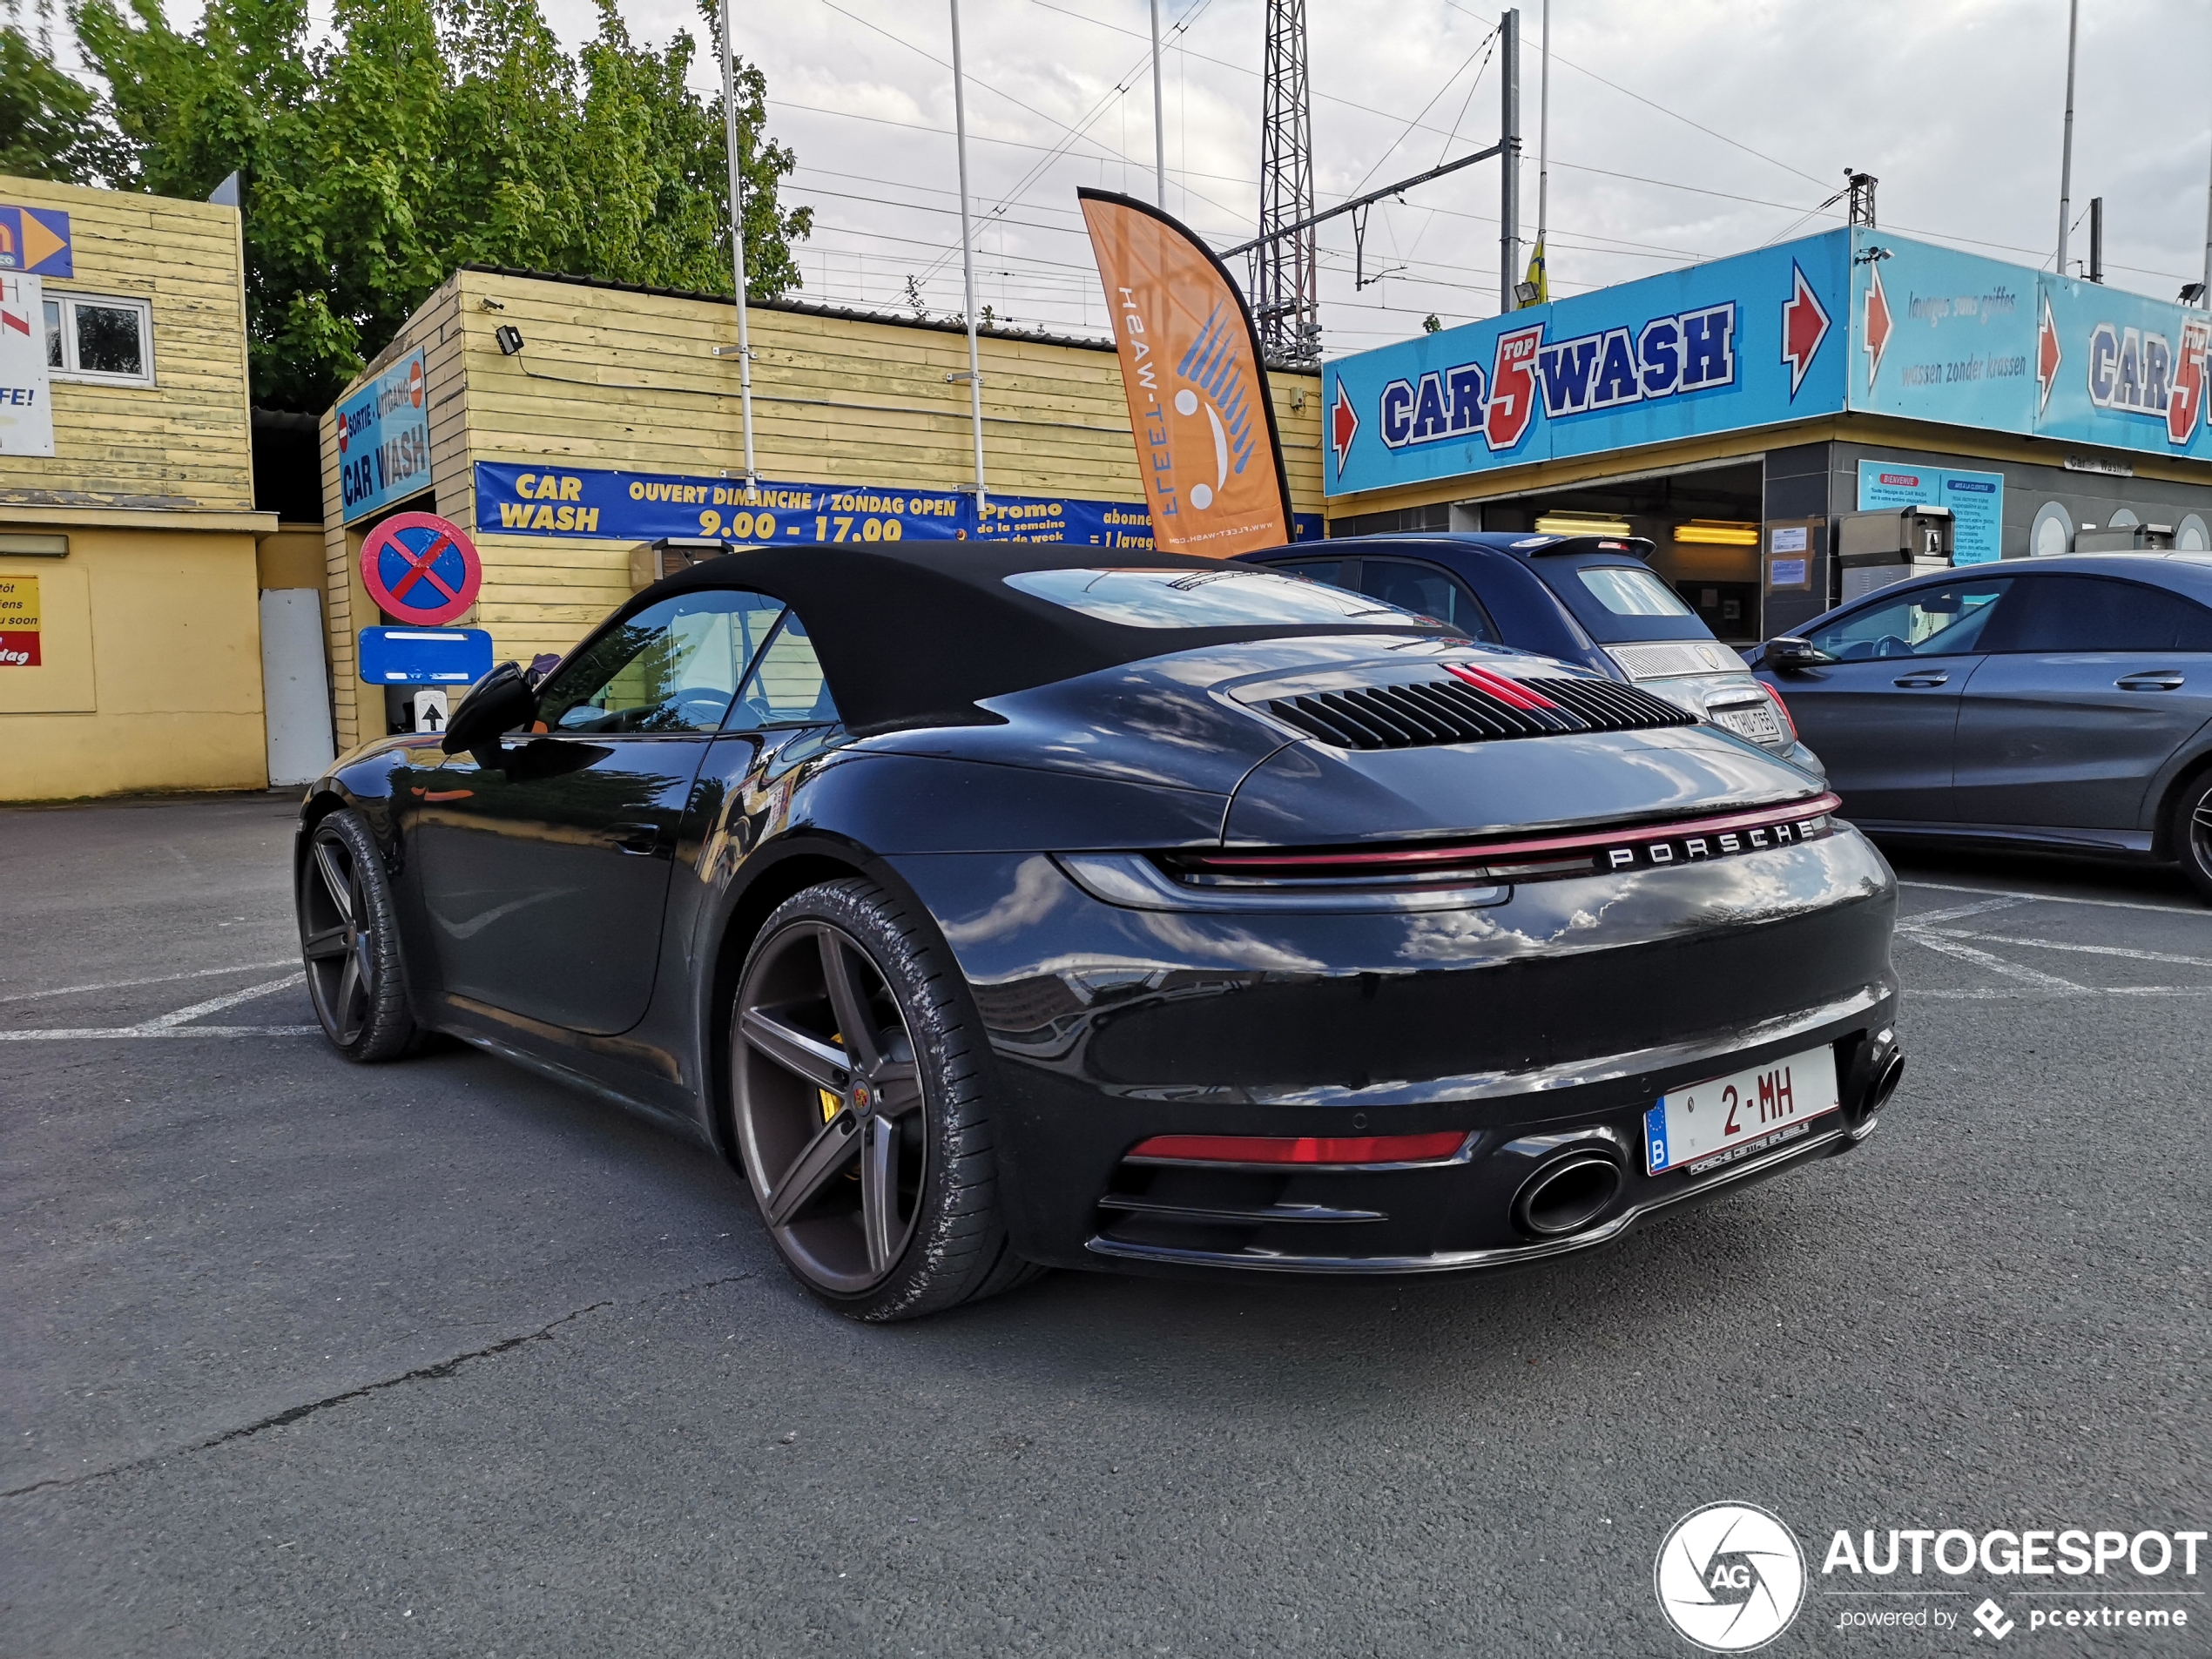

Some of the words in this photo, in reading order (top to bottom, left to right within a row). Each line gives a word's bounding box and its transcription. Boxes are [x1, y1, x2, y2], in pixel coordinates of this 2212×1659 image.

[1981, 285, 2016, 326] griffes
[1503, 337, 1534, 361] TOP
[2184, 329, 2206, 350] TOP
[1379, 361, 1488, 450] CAR
[1534, 299, 1737, 420] WASH
[1901, 362, 1942, 388] wassen
[1946, 353, 1984, 384] zonder
[1986, 350, 2027, 380] krassen
[2088, 322, 2171, 420] CAR
[347, 402, 373, 439] SORTIE
[375, 378, 409, 420] UITGANG
[343, 454, 374, 507] CAR
[375, 422, 426, 490] WASH
[2070, 455, 2086, 469] Car
[2100, 457, 2122, 474] Wash
[515, 473, 583, 502] CAR
[1883, 475, 1915, 485] BIENVENUE
[629, 481, 708, 504] OUVERT
[712, 486, 813, 511] DIMANCHE
[830, 494, 905, 515] ZONDAG
[909, 498, 957, 517] OPEN
[978, 502, 1063, 521] Promo
[499, 502, 600, 532] WASH
[698, 509, 776, 540] 9.00
[815, 516, 902, 543] 17.00
[976, 523, 994, 534] de
[997, 523, 1010, 532] la
[1014, 519, 1066, 531] semaine
[1030, 531, 1064, 543] week
[1116, 531, 1157, 551] lavag
[8, 617, 38, 625] soon
[1608, 820, 1816, 868] PORSCHE
[1721, 1066, 1794, 1137] 2-MH
[1652, 1139, 1665, 1165] B
[1690, 1150, 1732, 1174] PORSCHE
[1733, 1138, 1768, 1158] CENTRE
[1769, 1122, 1810, 1143] BRUSSELS
